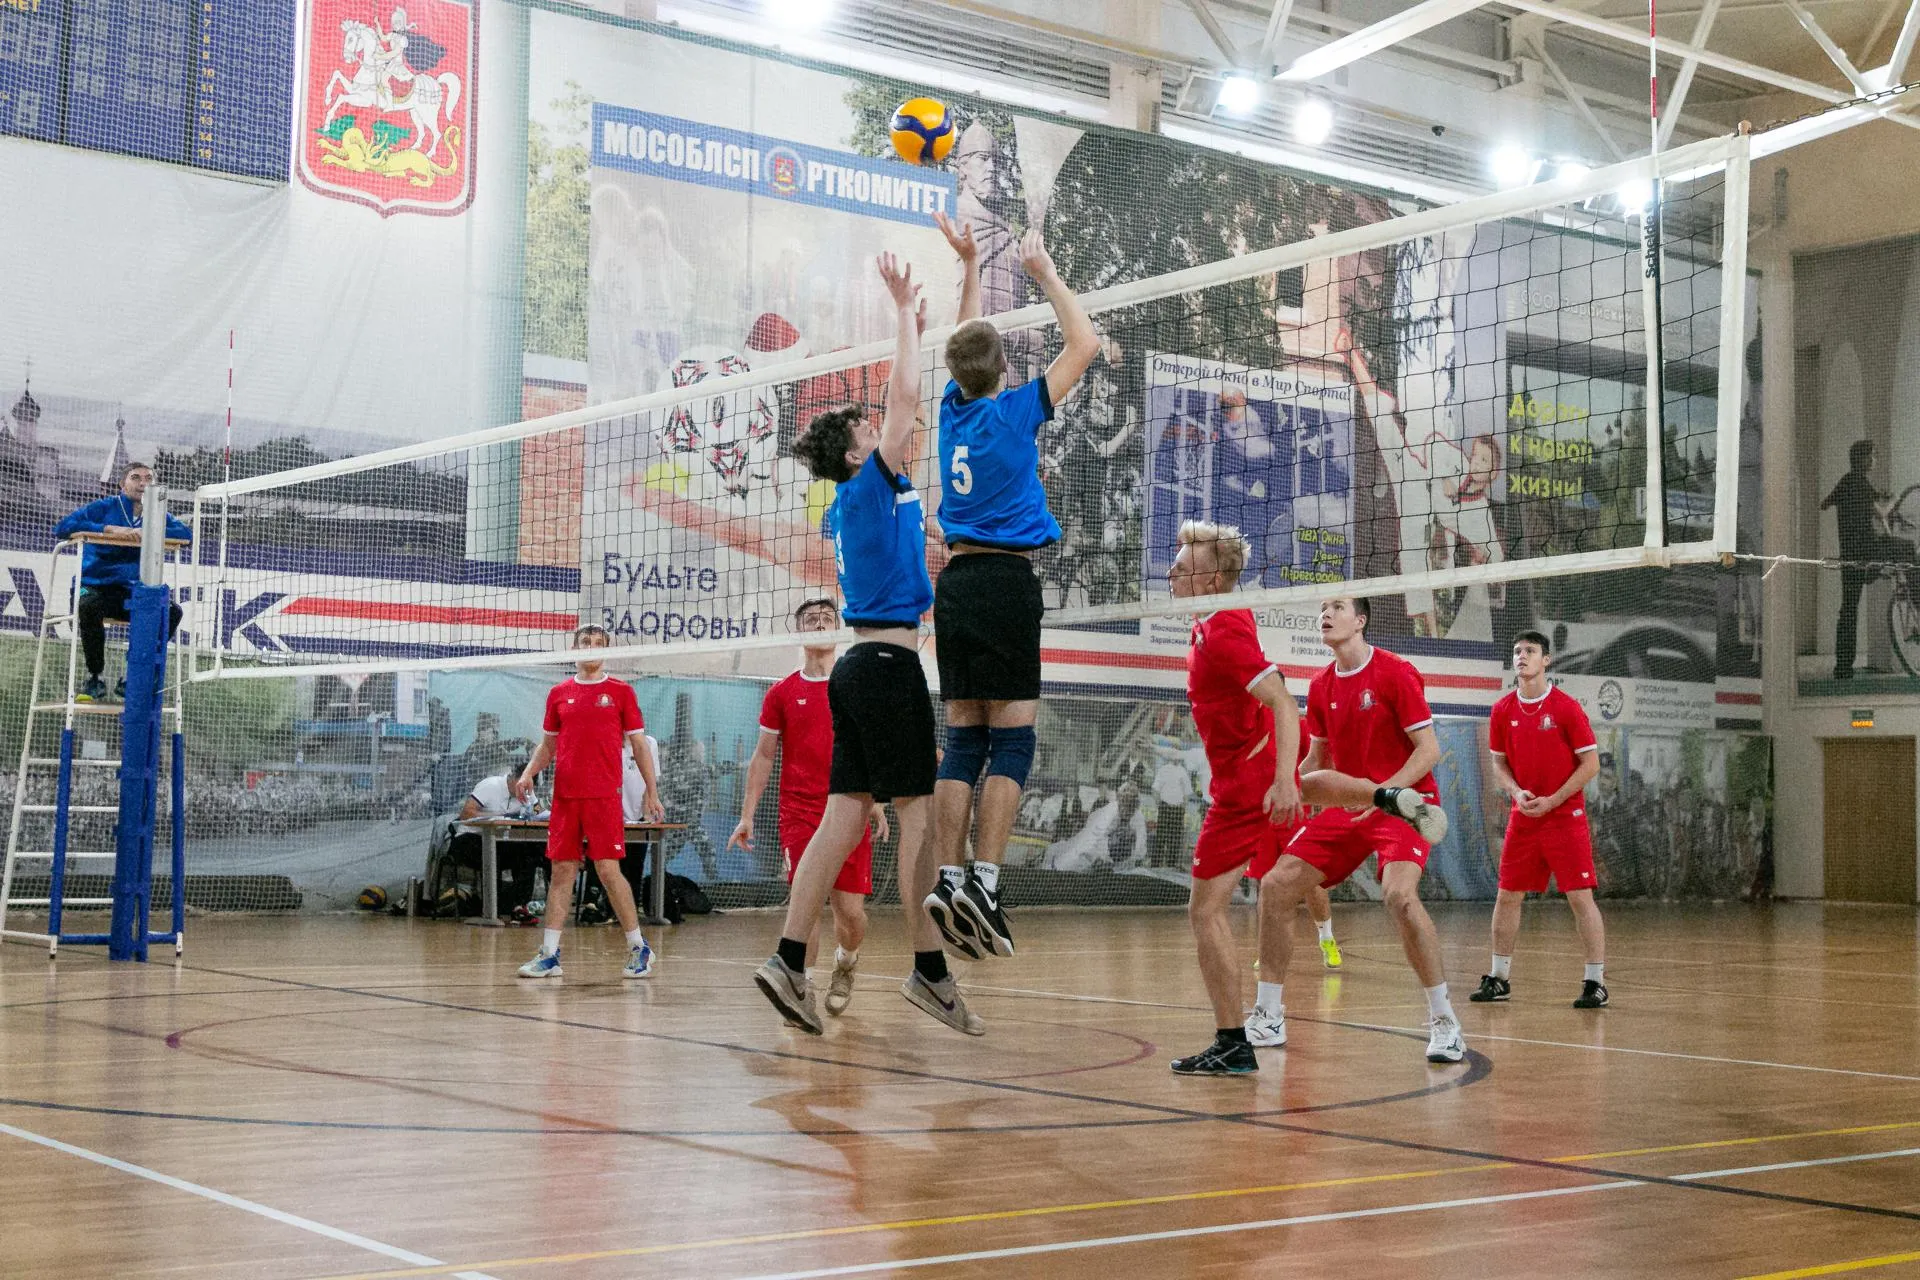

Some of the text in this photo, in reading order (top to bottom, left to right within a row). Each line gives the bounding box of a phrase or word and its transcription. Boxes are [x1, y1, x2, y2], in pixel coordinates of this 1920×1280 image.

[1153, 357, 1210, 380] Открой
[1215, 367, 1249, 384] Окно
[1251, 377, 1260, 388] в
[1263, 375, 1292, 394] Мир
[951, 445, 973, 496] 5
[603, 551, 719, 593] Будьте
